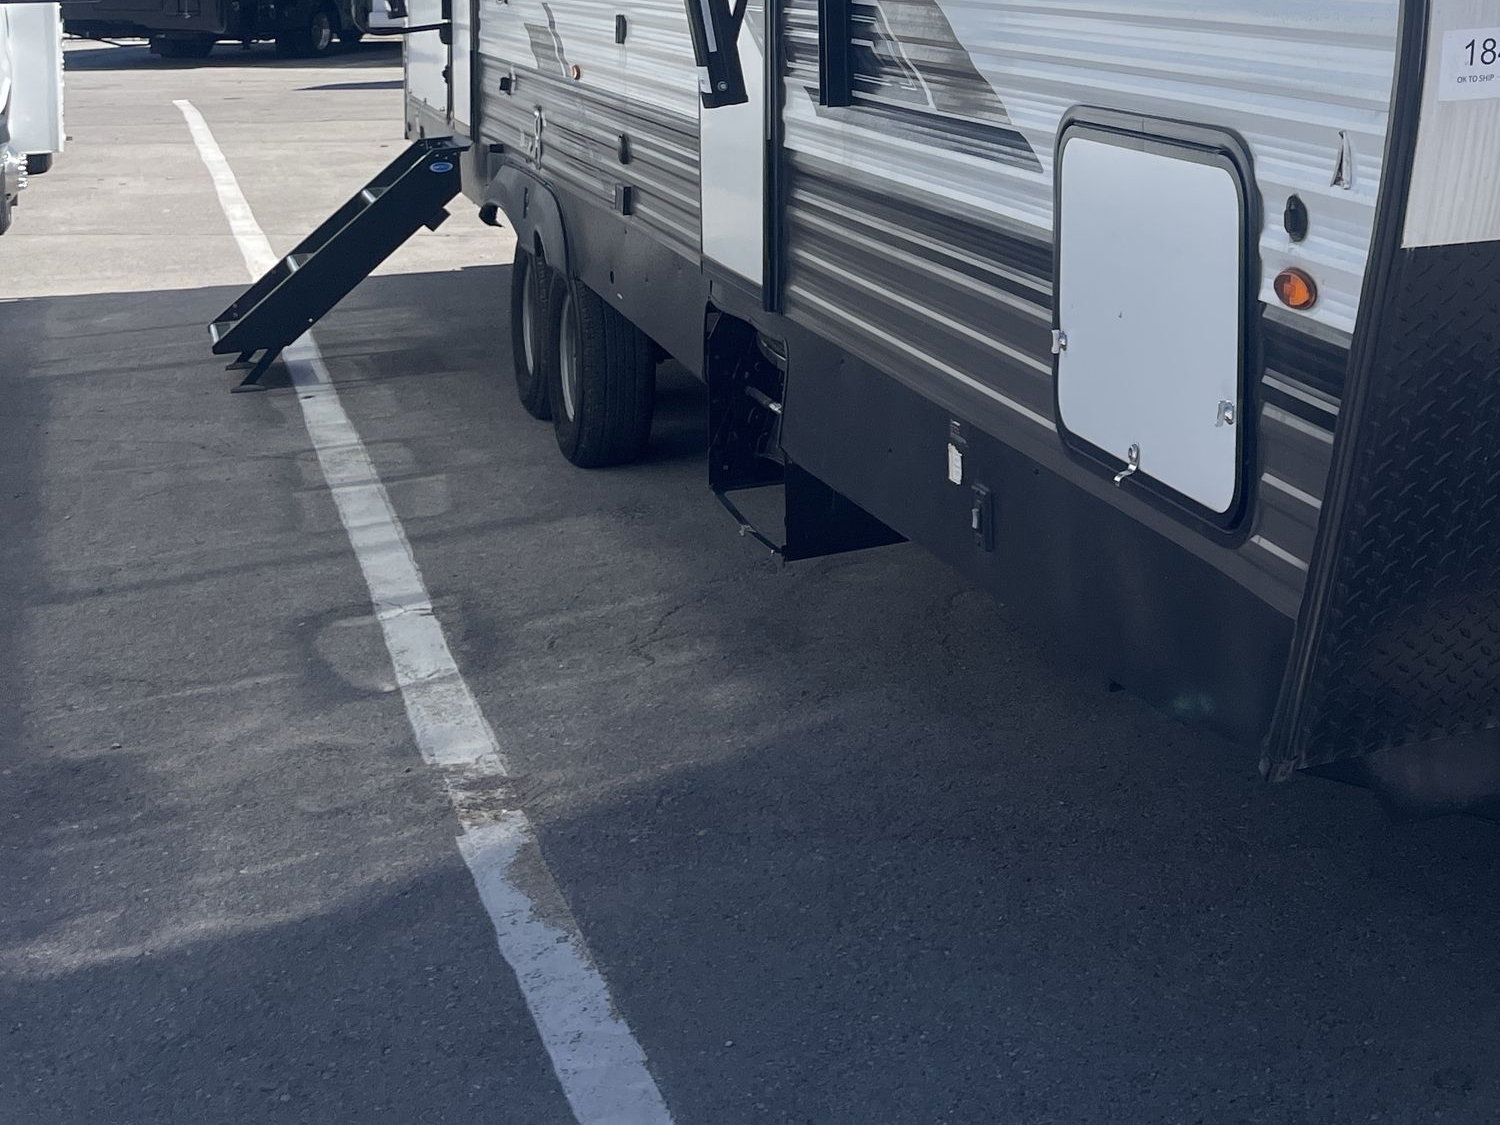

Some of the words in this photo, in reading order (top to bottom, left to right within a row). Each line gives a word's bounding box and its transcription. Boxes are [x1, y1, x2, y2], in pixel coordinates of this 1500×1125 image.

[1457, 76, 1467, 84] OK
[1469, 75, 1478, 83] TO
[1479, 74, 1495, 82] SHIP
